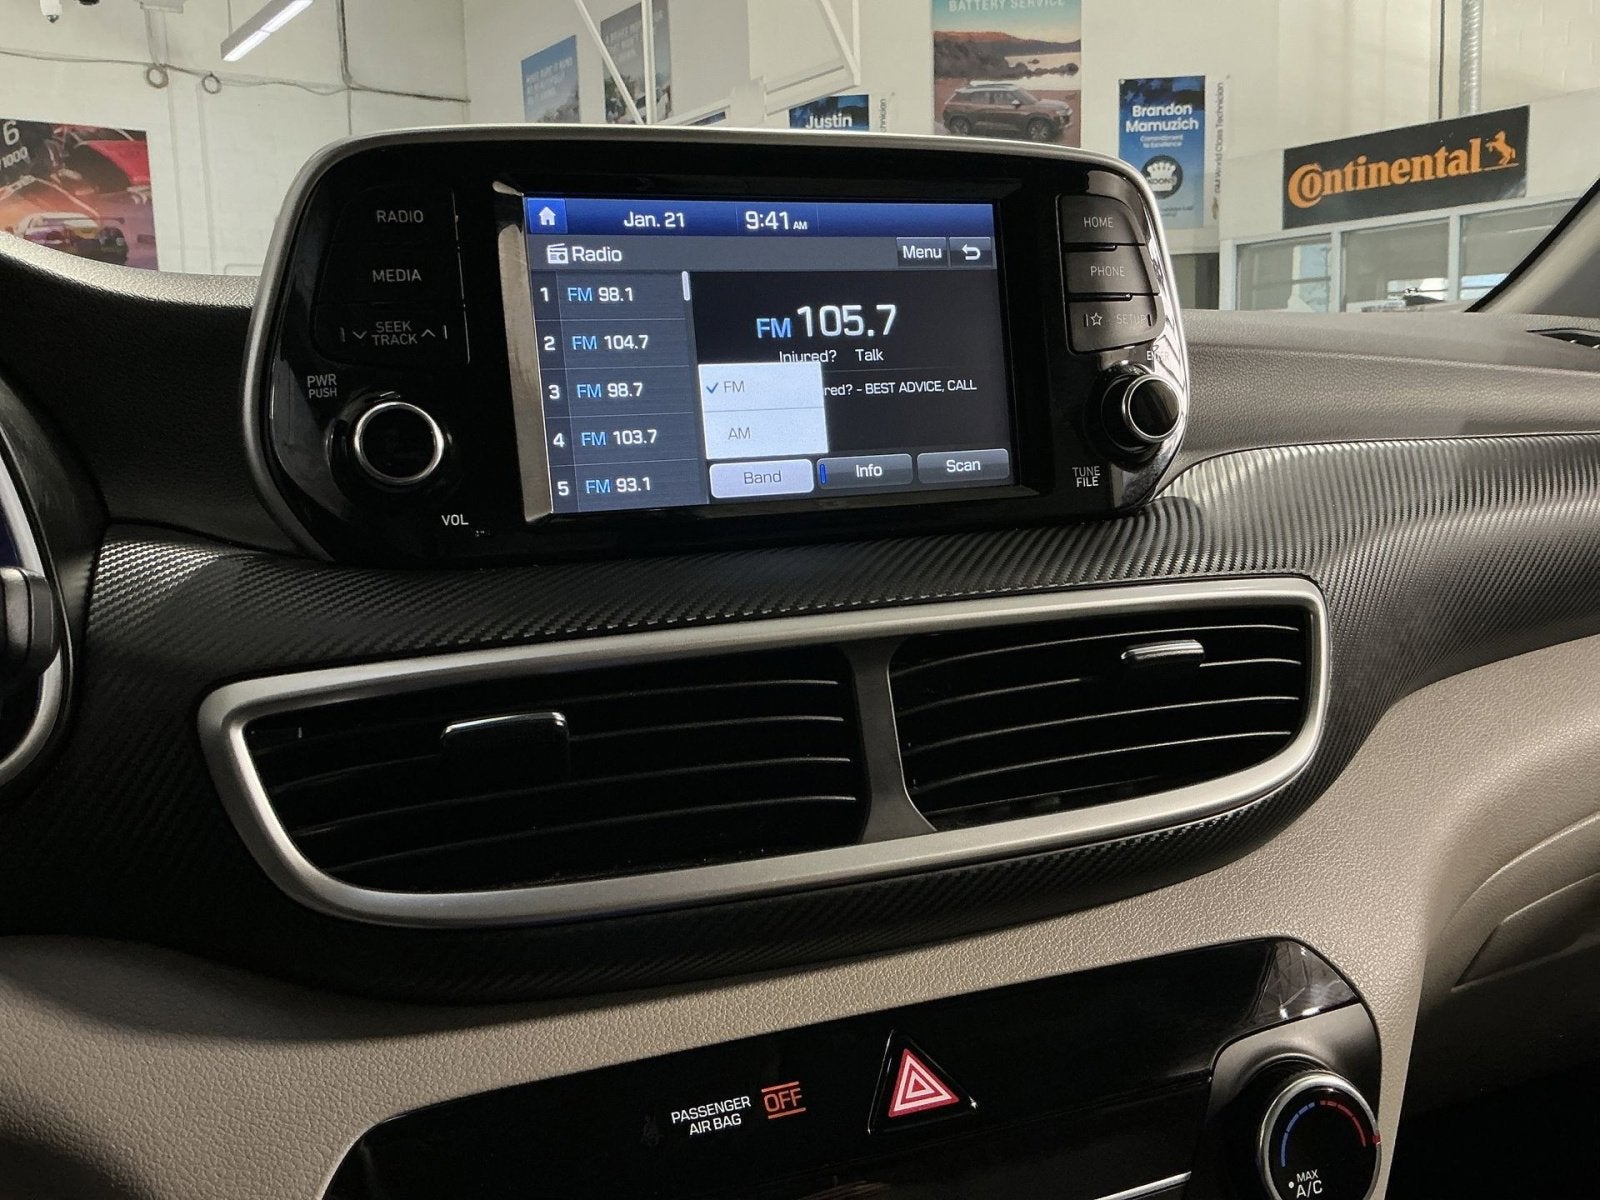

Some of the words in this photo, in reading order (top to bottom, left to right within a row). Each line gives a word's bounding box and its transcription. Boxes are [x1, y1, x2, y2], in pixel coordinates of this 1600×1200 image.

[948, 0, 1005, 12] BATTERY
[1132, 102, 1193, 117] Brandon
[1215, 82, 1224, 128] Technician
[805, 112, 853, 129] Justin
[3, 120, 20, 146] 6
[1215, 129, 1223, 152] Class
[0, 146, 28, 168] 1000
[1214, 153, 1222, 178] World
[1288, 138, 1482, 209] Continental
[376, 210, 424, 224] RADIO
[623, 211, 661, 228] Jan.
[664, 212, 685, 228] 21
[745, 210, 789, 230] 9:41
[793, 221, 808, 230] AM
[1083, 216, 1114, 228] HOME
[571, 246, 623, 263] Radio
[902, 245, 942, 260] Menu
[372, 268, 422, 283] MEDIA
[1090, 265, 1126, 277] PHONE
[540, 287, 549, 302] 1
[567, 287, 593, 302] FM
[598, 287, 633, 302] 98.1
[756, 317, 792, 338] FM
[797, 303, 897, 338] 105.7
[1116, 313, 1147, 325] SETUP
[375, 321, 412, 334] SEEK
[371, 333, 418, 346] TRACK
[543, 336, 556, 351] 2
[572, 335, 597, 350] FM
[604, 334, 649, 349] 104.7
[779, 349, 837, 362] Injured?
[854, 348, 884, 361] Talk
[307, 373, 337, 387] PWR
[724, 380, 745, 393] FM
[824, 384, 853, 396] red?
[865, 382, 895, 395] BEST
[898, 380, 945, 393] ADVICE,
[947, 379, 977, 391] CALL
[308, 387, 337, 399] PUSH
[549, 384, 560, 400] 3
[576, 383, 602, 398] FM
[607, 382, 643, 397] 98.7
[552, 432, 565, 448] 4
[581, 431, 606, 446] FM
[613, 430, 658, 445] 103.7
[728, 427, 750, 440] AM
[856, 463, 883, 478] Info
[946, 459, 981, 473] Scan
[1072, 465, 1101, 477] TUNE
[743, 470, 782, 485] Band
[1076, 476, 1099, 488] FILE
[557, 481, 569, 496] 5
[586, 479, 611, 494] FM
[616, 477, 651, 492] 93.1
[441, 514, 469, 526] VOL
[764, 1088, 802, 1112] OFF
[671, 1096, 751, 1123] PASSENGER
[689, 1121, 712, 1136] AIR
[713, 1112, 742, 1131] BAG
[1296, 1169, 1318, 1182] MAX
[1296, 1179, 1323, 1199] A/C
